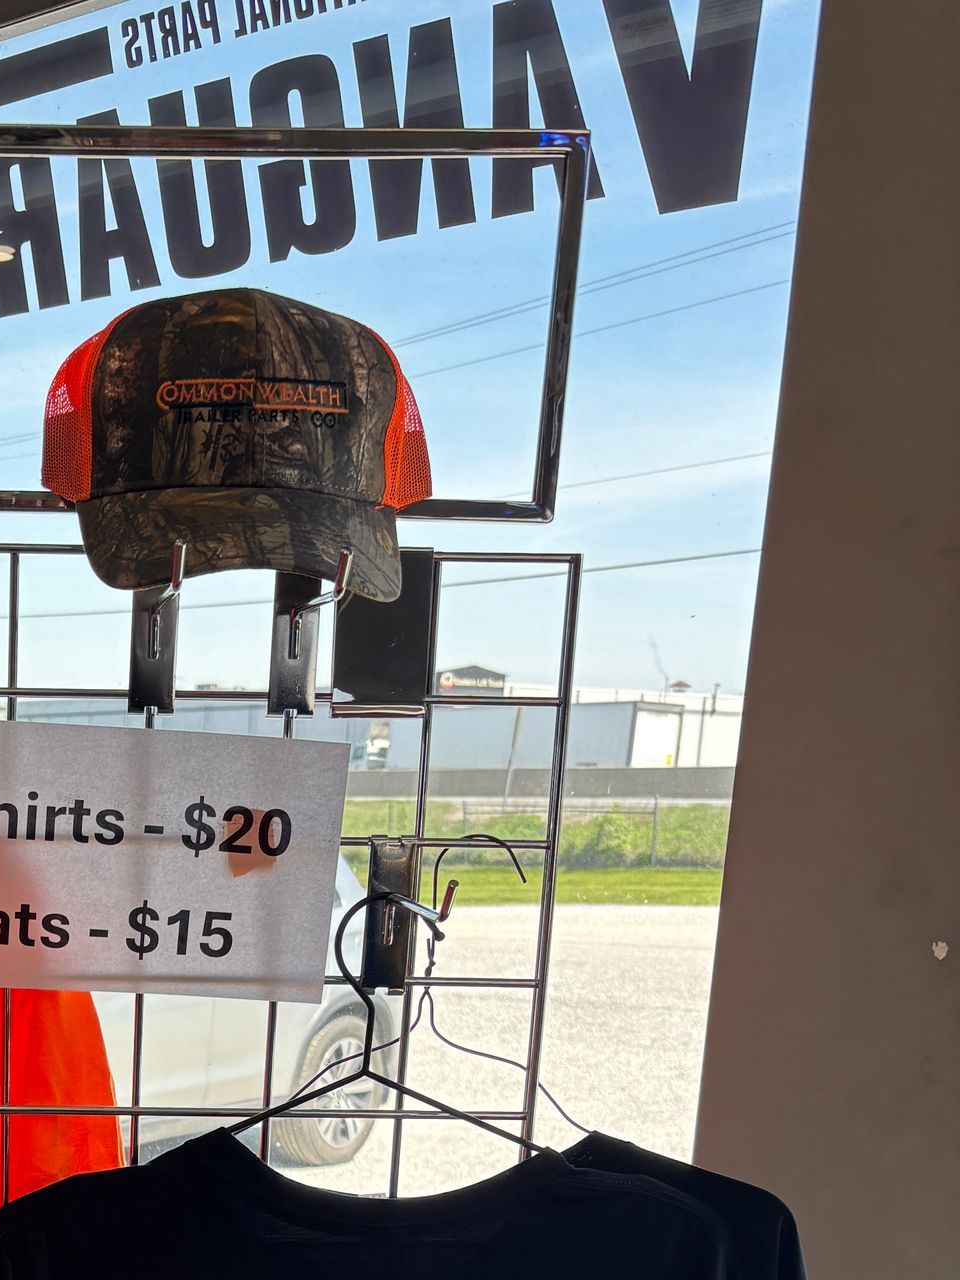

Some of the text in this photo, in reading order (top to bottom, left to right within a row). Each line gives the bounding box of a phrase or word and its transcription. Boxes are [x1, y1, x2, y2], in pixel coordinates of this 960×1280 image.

[156, 381, 340, 410] COMMONWEALTH
[178, 409, 299, 424] TRAILER PARTS
[181, 795, 292, 858] $20
[125, 900, 233, 961] $15
